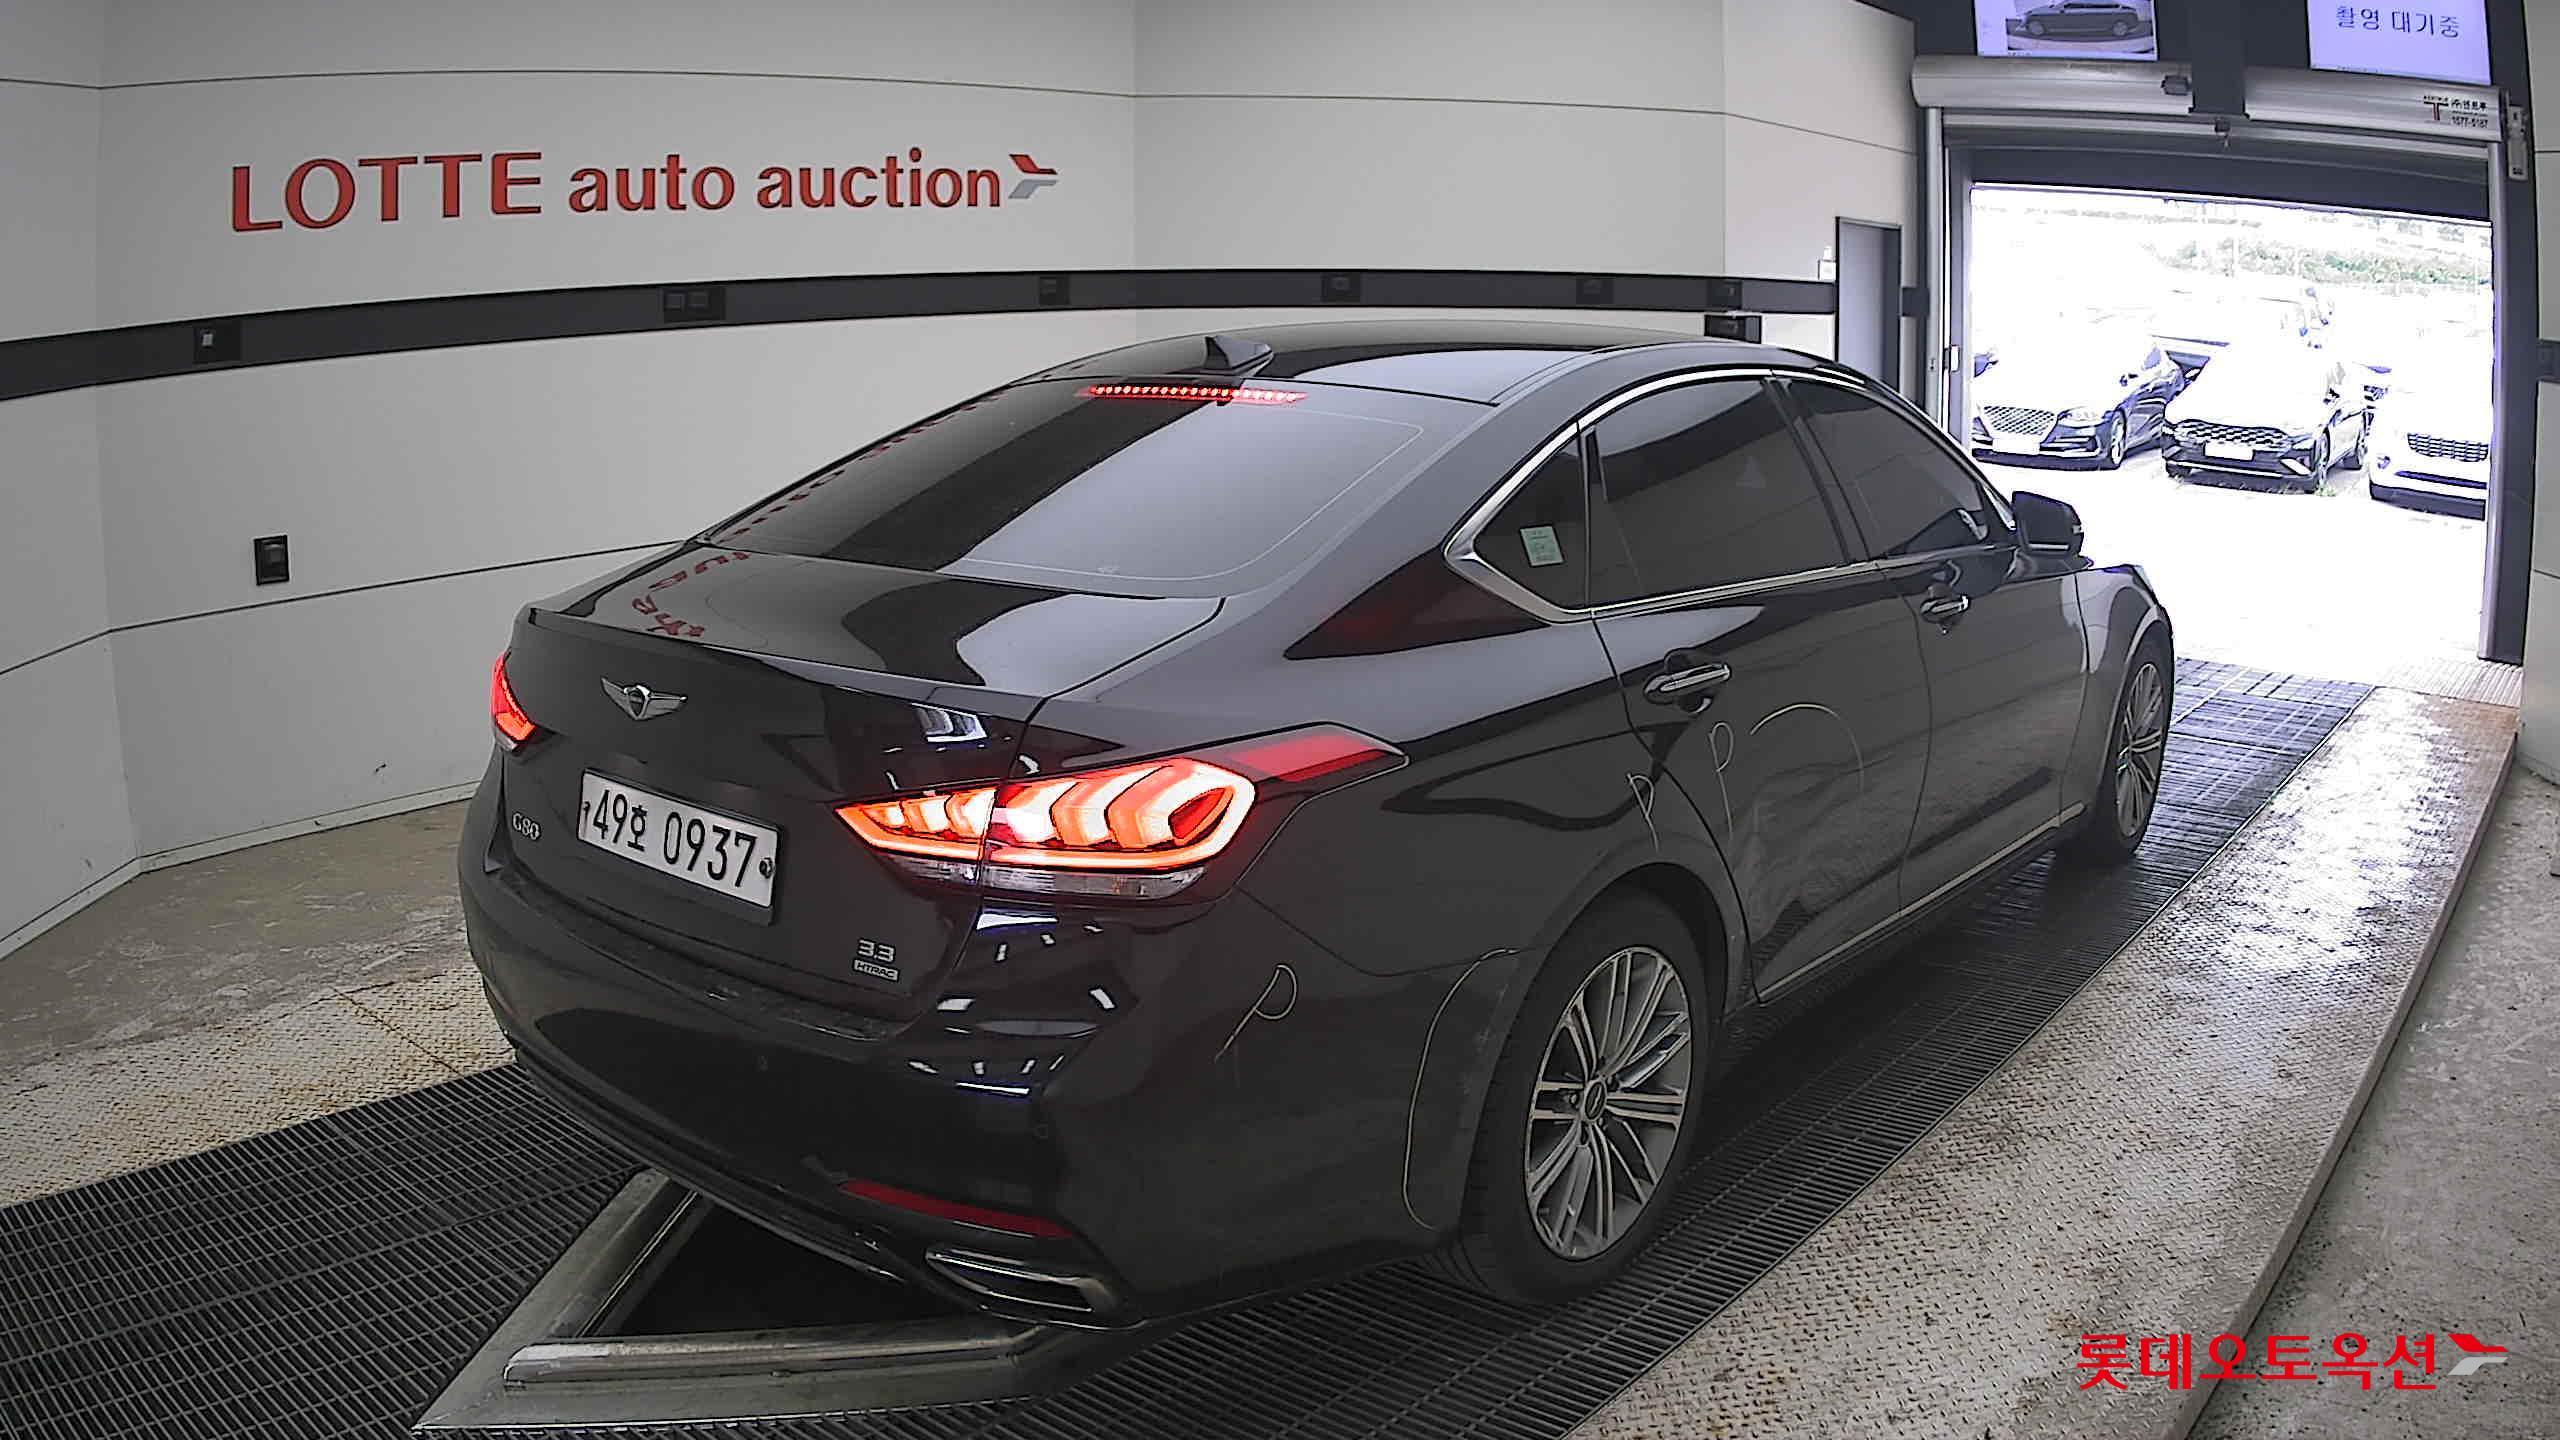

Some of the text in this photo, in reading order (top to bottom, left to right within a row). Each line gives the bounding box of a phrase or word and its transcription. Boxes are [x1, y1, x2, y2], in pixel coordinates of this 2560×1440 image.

[2336, 5, 2461, 39] 촬영 대기중
[231, 147, 1001, 233] LOTTE auto auction
[512, 812, 541, 840] G80
[592, 788, 758, 888] 49호 0937
[857, 939, 895, 963] 3.3
